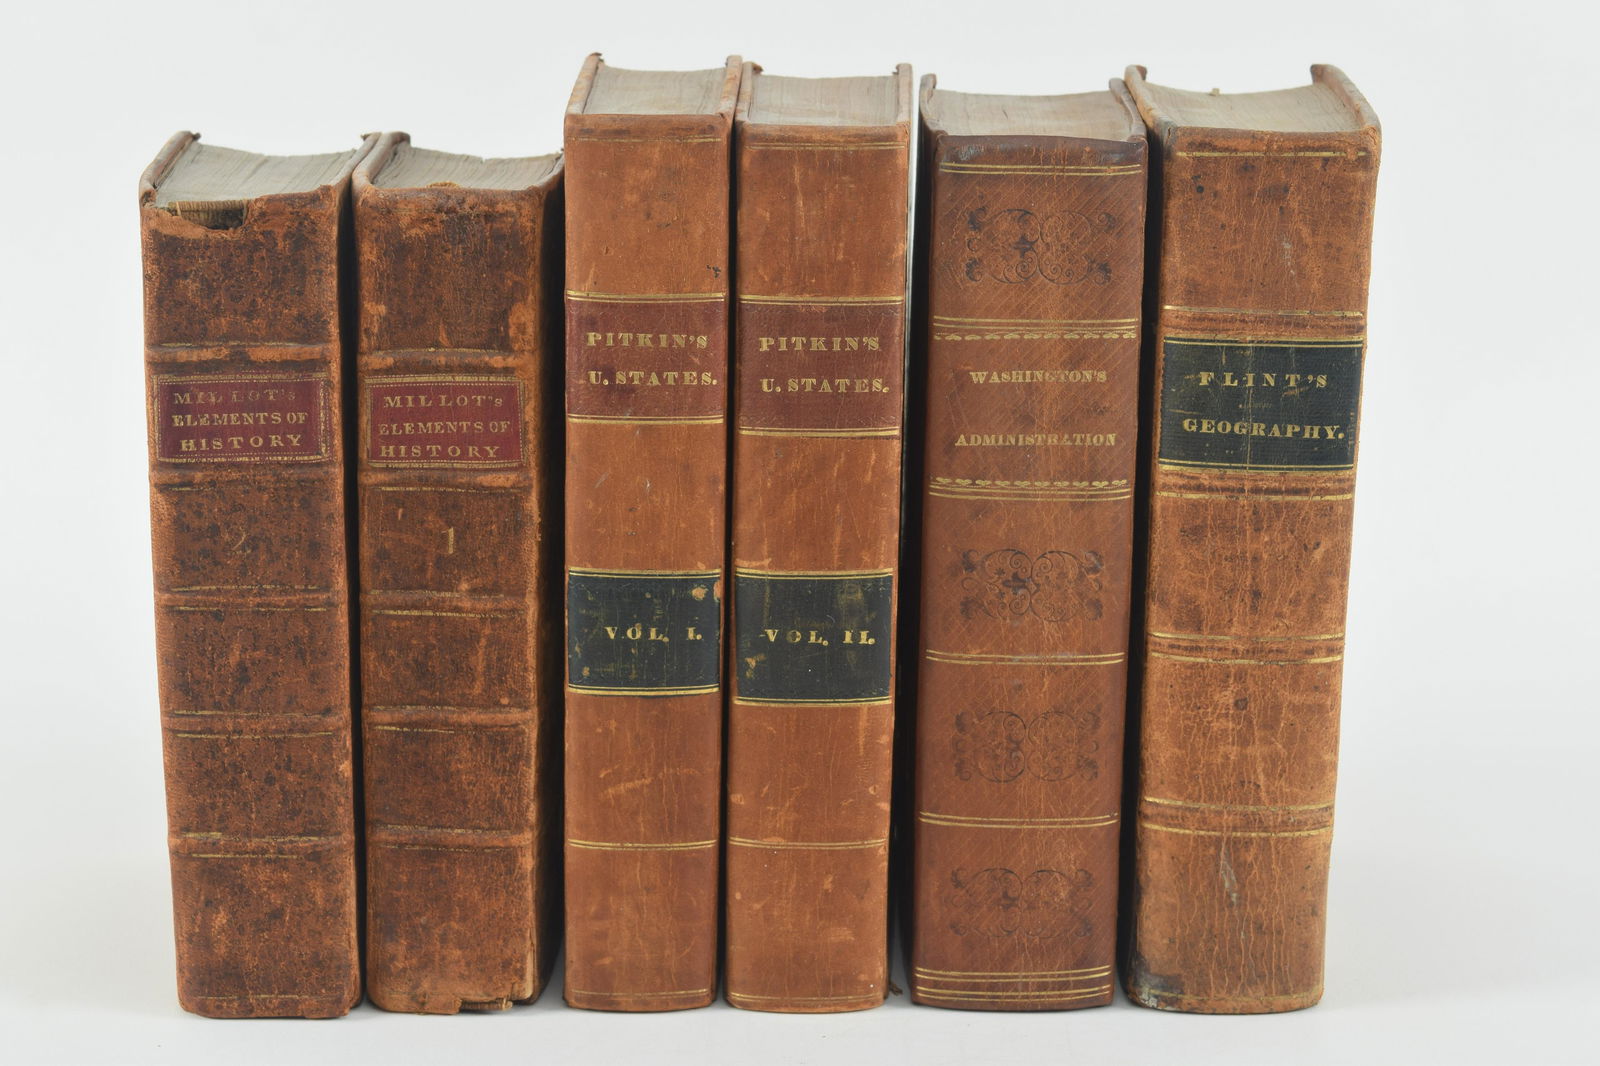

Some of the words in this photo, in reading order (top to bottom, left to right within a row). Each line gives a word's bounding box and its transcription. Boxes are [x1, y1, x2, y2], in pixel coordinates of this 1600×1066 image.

[586, 332, 708, 349] PITKIN'S
[759, 336, 880, 352] PITKIN'S
[587, 370, 609, 386] U.
[615, 371, 718, 386] STATES.
[969, 370, 1107, 384] WASHINGTON'S
[1199, 371, 1328, 388] FLINT'S
[760, 378, 782, 393] U.
[787, 378, 890, 393] STATES.
[171, 412, 282, 427] ELEMENTS
[287, 412, 309, 424] OF
[378, 421, 484, 436] ELEMENTS
[489, 421, 511, 433] OF
[1182, 418, 1346, 439] GEOGRAPHY.
[180, 434, 302, 451] HISTORY
[954, 433, 1118, 447] ADMINISTRATION
[379, 445, 500, 458] HISTORY
[604, 625, 669, 642] VOL.
[686, 626, 702, 641] I.
[764, 629, 829, 646] VOL.
[842, 630, 876, 645] II.
